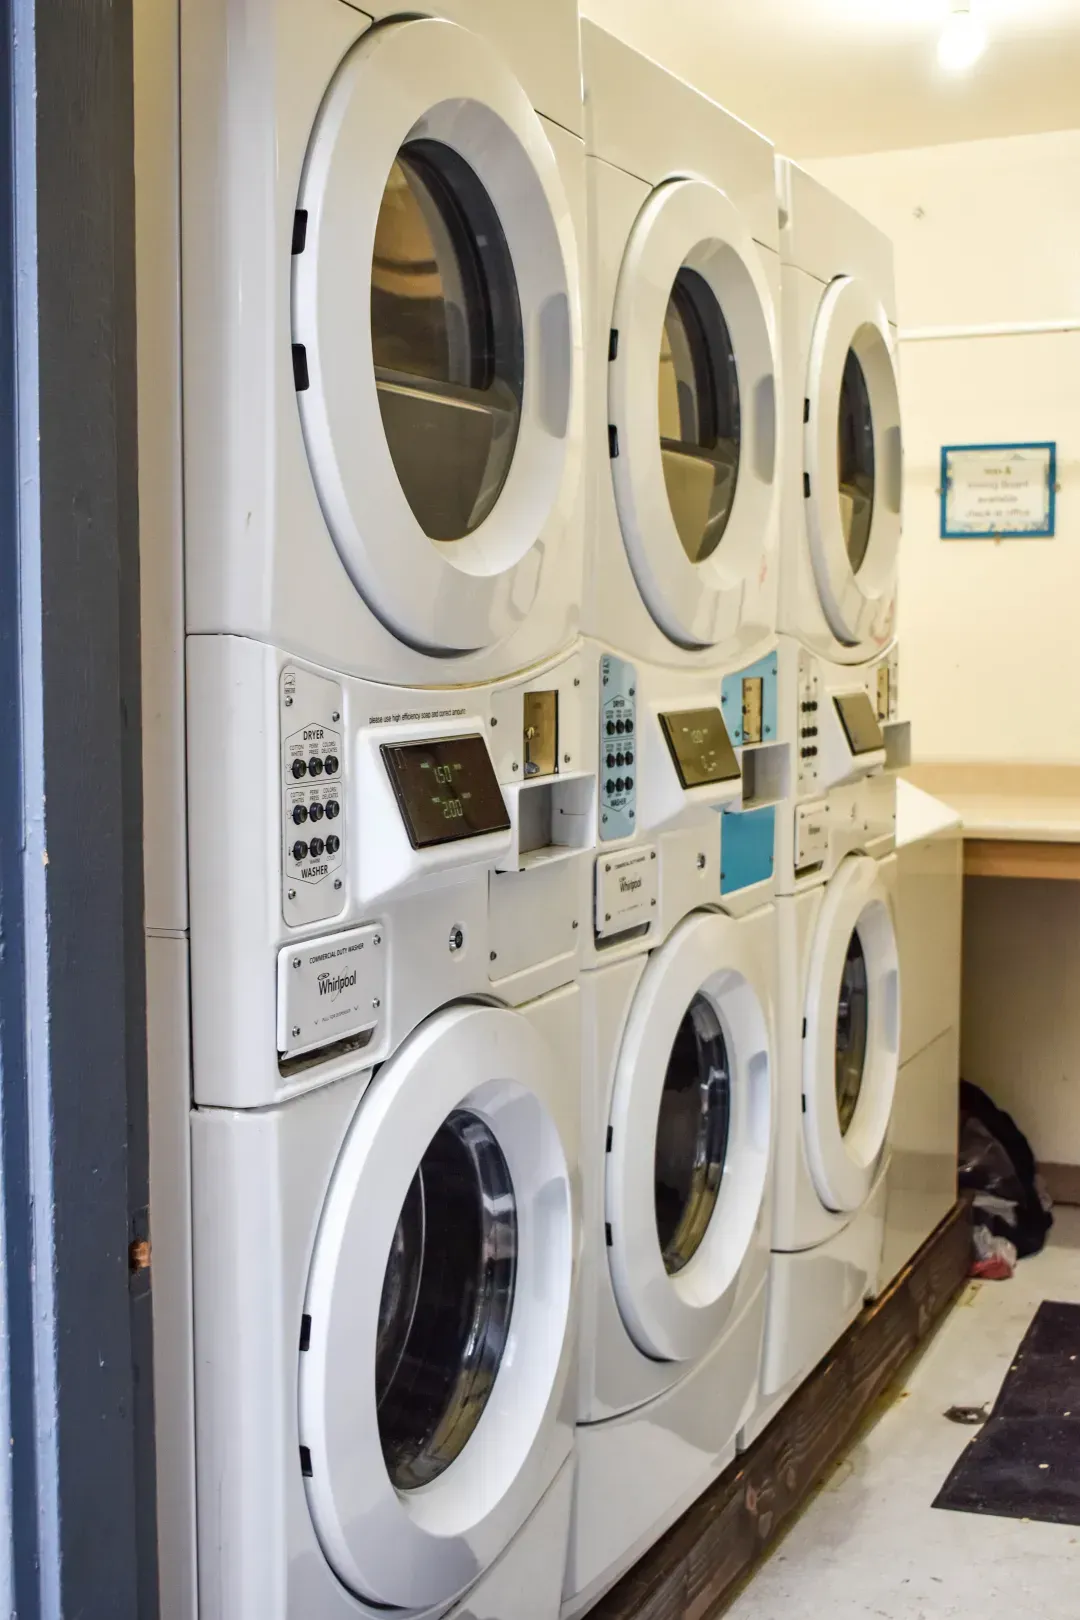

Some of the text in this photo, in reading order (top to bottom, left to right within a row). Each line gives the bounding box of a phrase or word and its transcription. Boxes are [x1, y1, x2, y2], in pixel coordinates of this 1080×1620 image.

[303, 729, 324, 740] DRYER
[301, 864, 328, 879] WASHER
[309, 942, 365, 965] COMMERCIAL DUTY WASHER
[318, 970, 357, 996] Whirlpool
